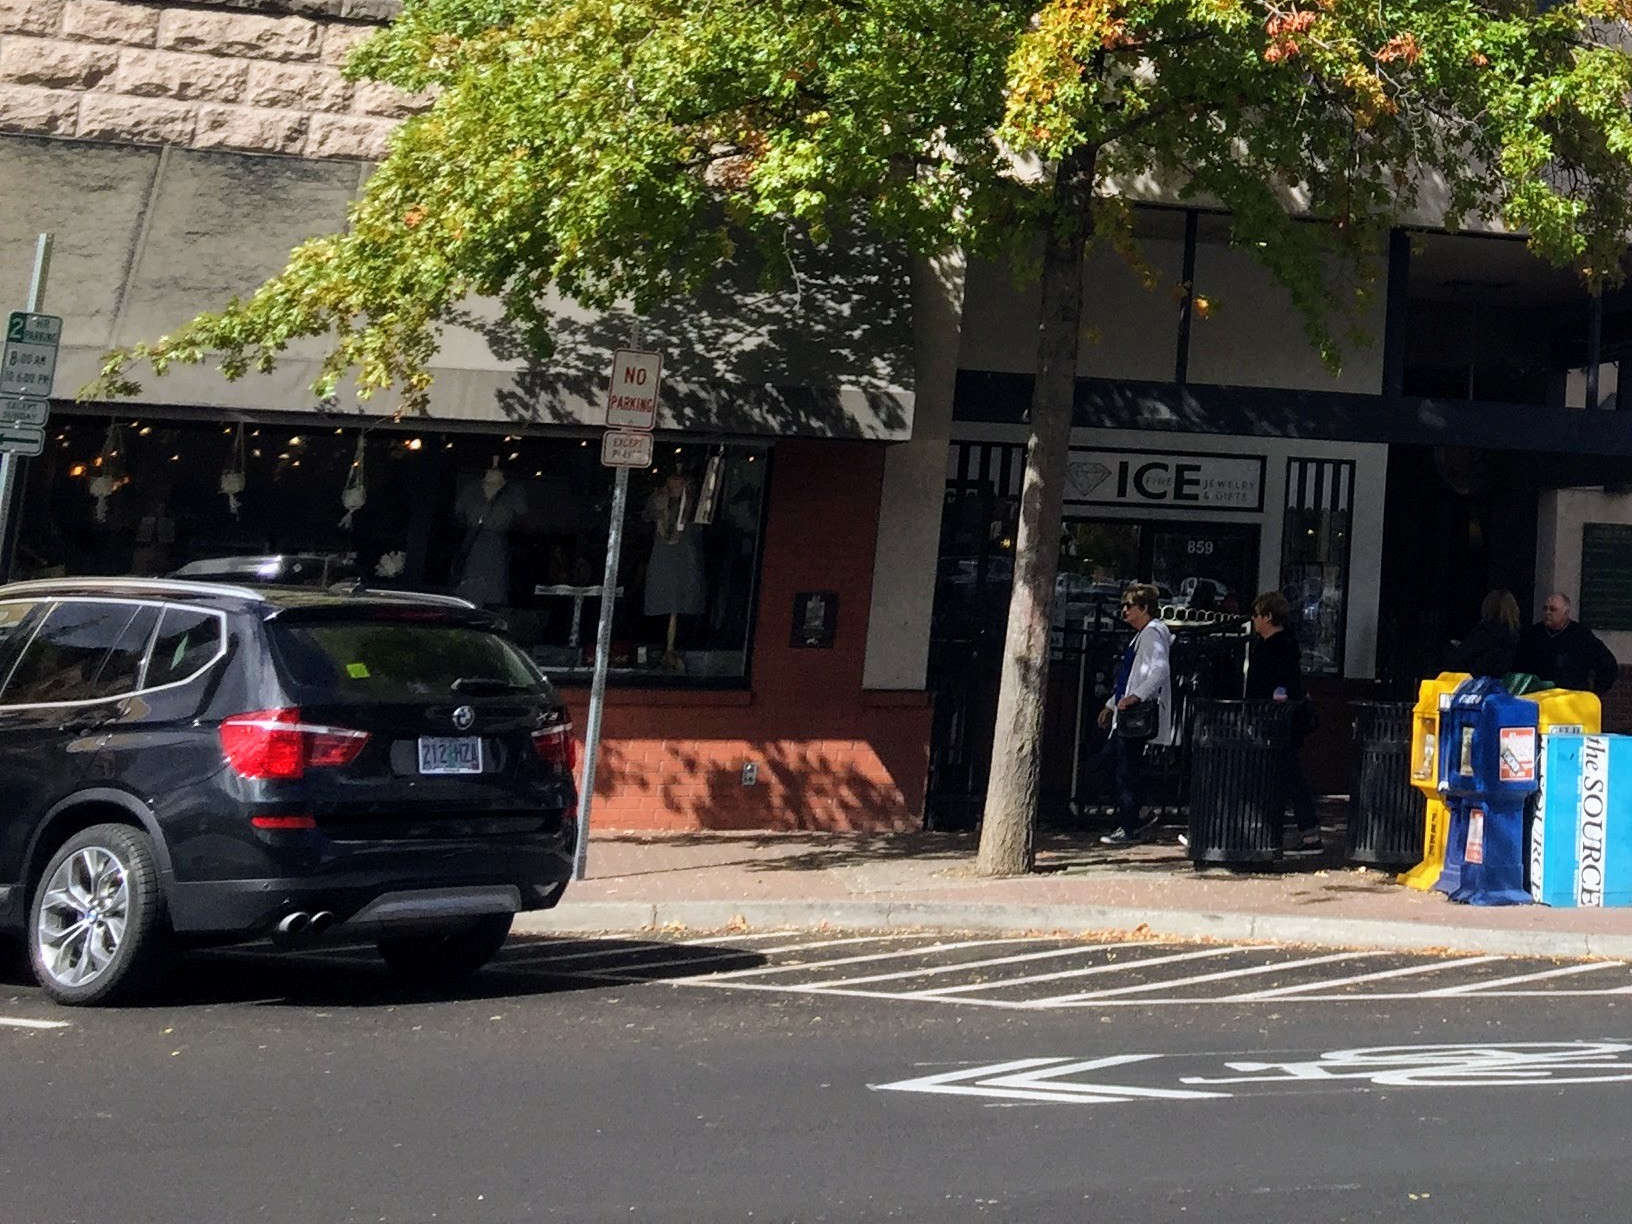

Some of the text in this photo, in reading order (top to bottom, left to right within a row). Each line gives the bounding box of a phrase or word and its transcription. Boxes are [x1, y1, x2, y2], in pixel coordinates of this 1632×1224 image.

[10, 317, 24, 339] 2
[624, 366, 647, 386] NO
[610, 395, 654, 413] PARKING
[1116, 460, 1202, 501] ICE
[1202, 479, 1256, 490] JEWELRY
[1186, 539, 1214, 556] 859
[1579, 736, 1606, 908] the SOURCE
